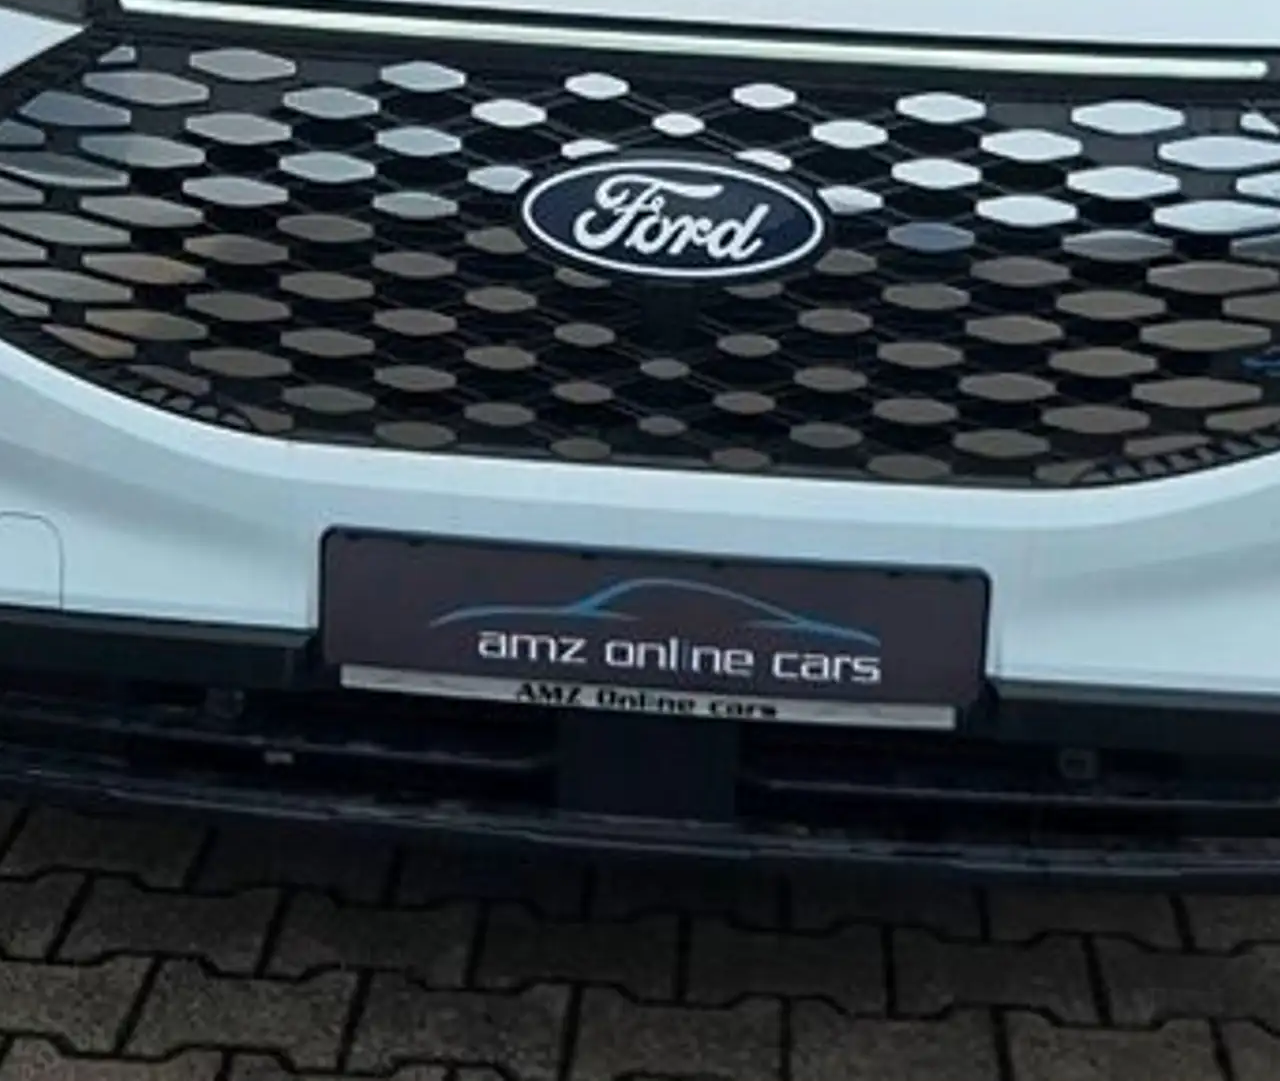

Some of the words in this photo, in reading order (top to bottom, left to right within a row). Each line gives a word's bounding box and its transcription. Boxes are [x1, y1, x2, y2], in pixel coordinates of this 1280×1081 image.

[573, 174, 769, 259] Ford
[478, 630, 587, 663] amz
[771, 650, 882, 685] cars
[596, 687, 697, 713] Onlne
